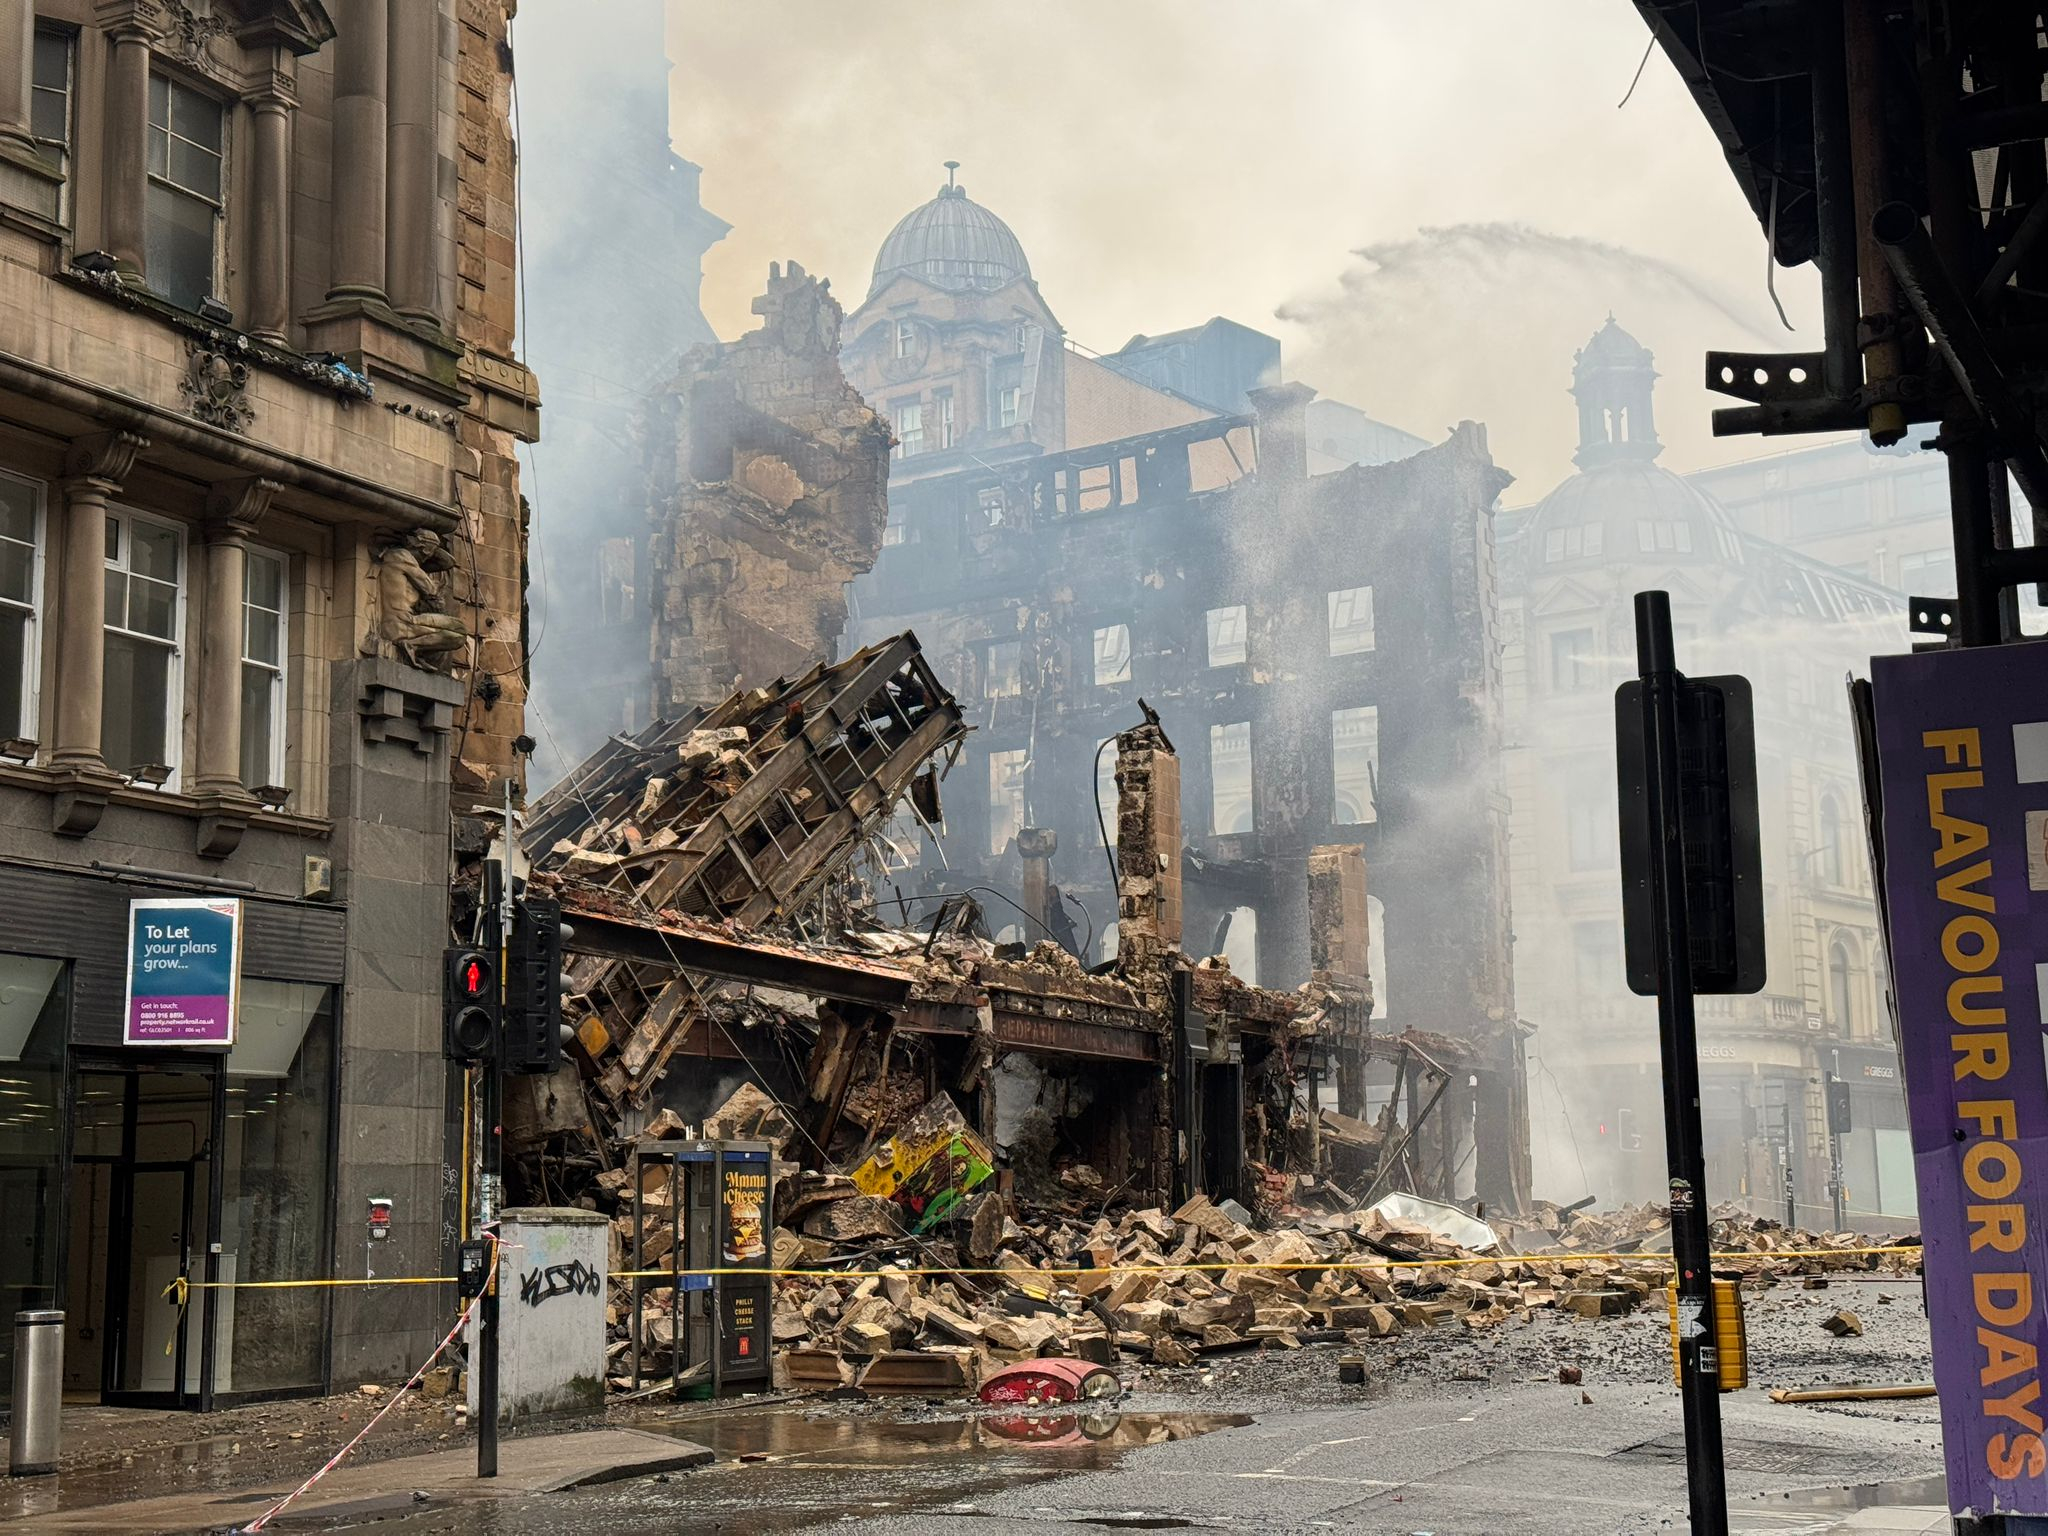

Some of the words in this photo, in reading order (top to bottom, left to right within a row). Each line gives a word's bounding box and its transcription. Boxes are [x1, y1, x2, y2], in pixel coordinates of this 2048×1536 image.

[1922, 728, 2010, 1082] FLAVOUR
[144, 925, 163, 939] To
[167, 925, 190, 939] Let
[144, 943, 176, 958] your
[180, 940, 217, 957] plans
[144, 958, 189, 972] grow...
[141, 1002, 152, 1010] Get
[1699, 1046, 1736, 1057] EGGS
[1957, 1100, 2026, 1252] FOR
[735, 1298, 753, 1306] PHILLY
[1973, 1273, 2047, 1480] DAYS
